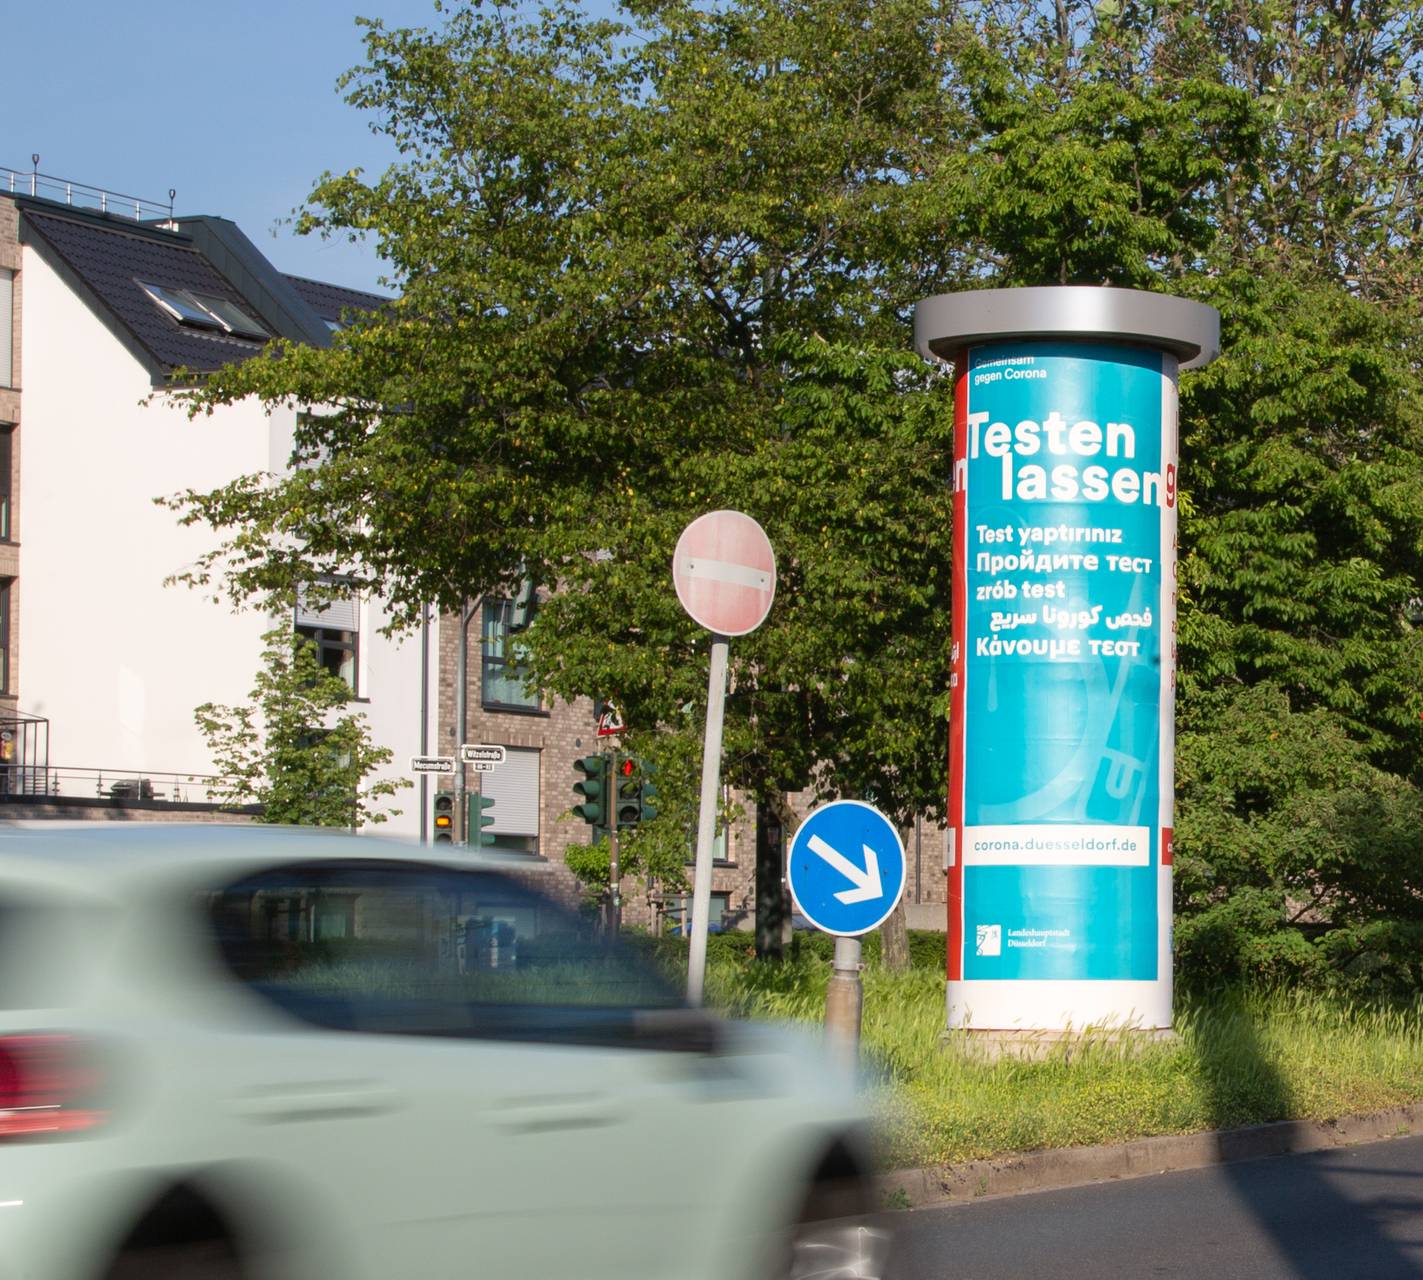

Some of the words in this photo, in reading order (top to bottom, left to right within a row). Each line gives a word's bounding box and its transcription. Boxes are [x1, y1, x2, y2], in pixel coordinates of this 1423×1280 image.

[975, 371, 1002, 385] gegen
[1004, 368, 1047, 379] Corona
[968, 411, 1135, 459] Testen
[1001, 451, 1161, 507] lassen
[976, 525, 1014, 544] Test
[1018, 524, 1123, 545] yaptırınız
[976, 549, 1098, 575] Пройдите
[1105, 555, 1152, 573] тест
[976, 580, 1017, 600] zrób
[1022, 580, 1065, 599] test
[974, 838, 1137, 851] corona.duesseldorf.de
[1007, 938, 1047, 948] Düsseldorf
